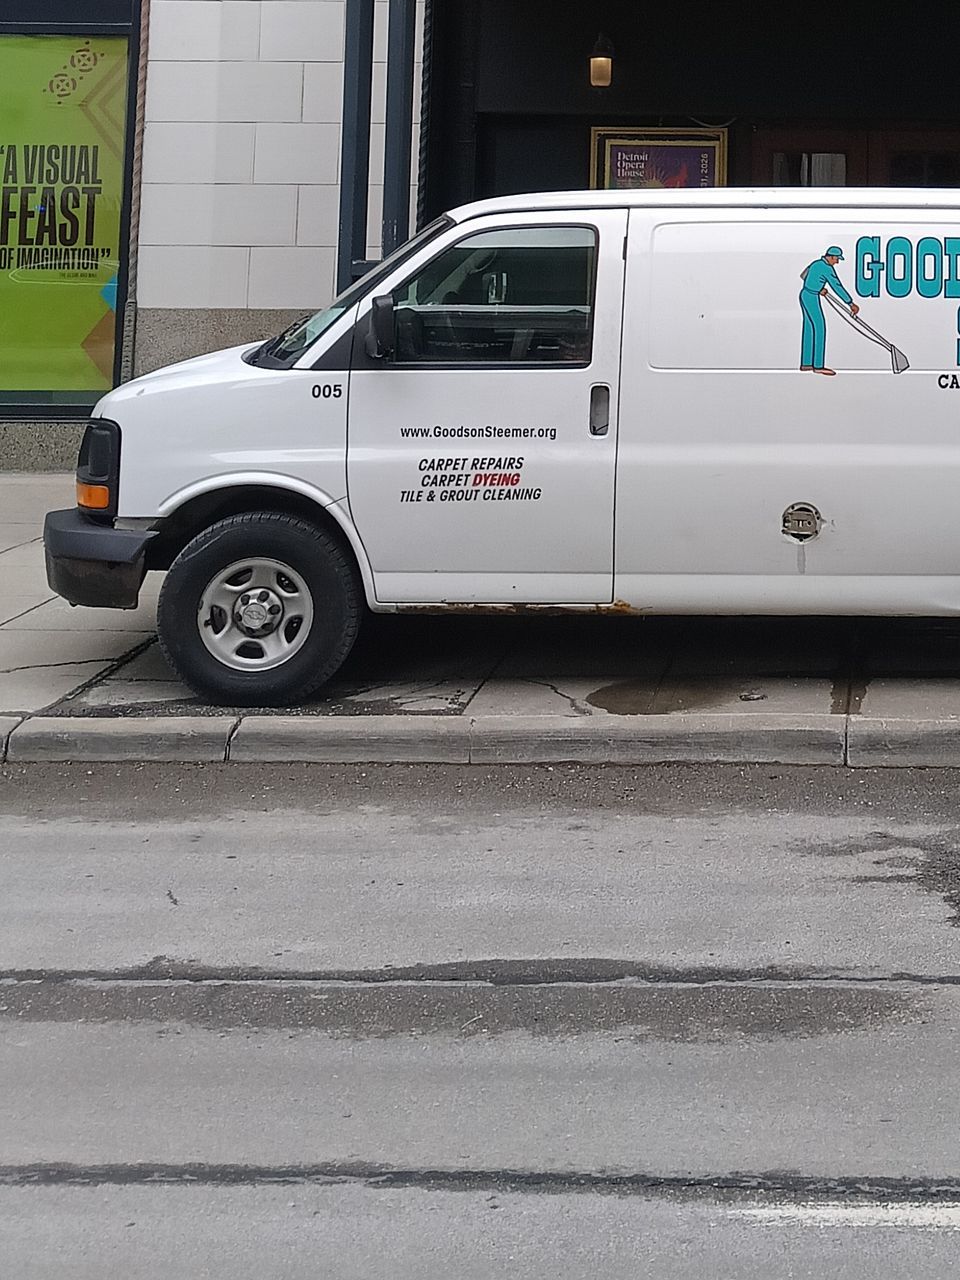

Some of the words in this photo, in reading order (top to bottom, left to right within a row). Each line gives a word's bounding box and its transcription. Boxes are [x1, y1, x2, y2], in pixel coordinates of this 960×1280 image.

[617, 152, 648, 161] Detroit
[23, 144, 102, 184] VISUAL
[617, 161, 644, 170] Opera
[617, 169, 644, 177] House
[0, 186, 102, 246] FEAST
[311, 384, 342, 399] 005
[400, 425, 557, 440] www.GoodsonSteemer.org
[418, 458, 468, 471] CARPET
[470, 457, 524, 470] REPAIRS
[421, 474, 471, 487] CARPET
[472, 473, 520, 487] DYEING
[400, 490, 423, 502] TILE
[426, 489, 436, 502] &
[439, 489, 480, 502] GROUT
[482, 488, 542, 501] CLEANING
